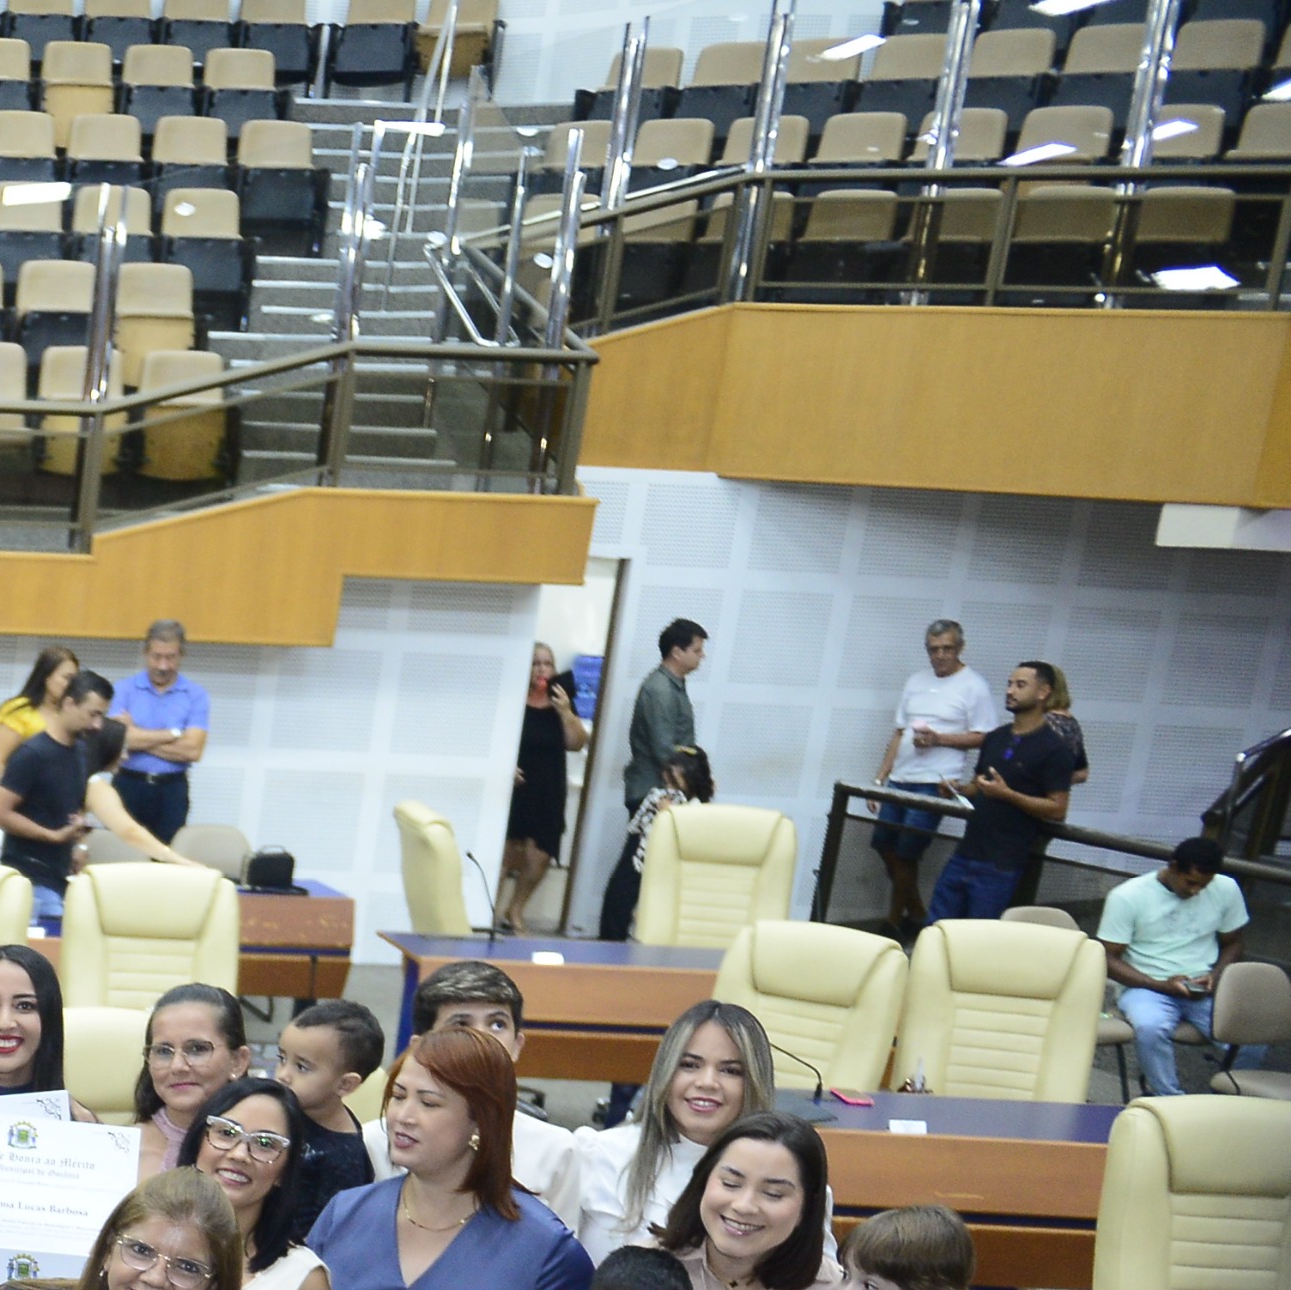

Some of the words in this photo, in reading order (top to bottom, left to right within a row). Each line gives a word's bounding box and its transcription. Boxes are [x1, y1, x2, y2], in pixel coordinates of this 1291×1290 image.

[45, 1158, 55, 1166] ao
[18, 1202, 46, 1212] Lucas
[49, 1205, 88, 1216] Barbosa
